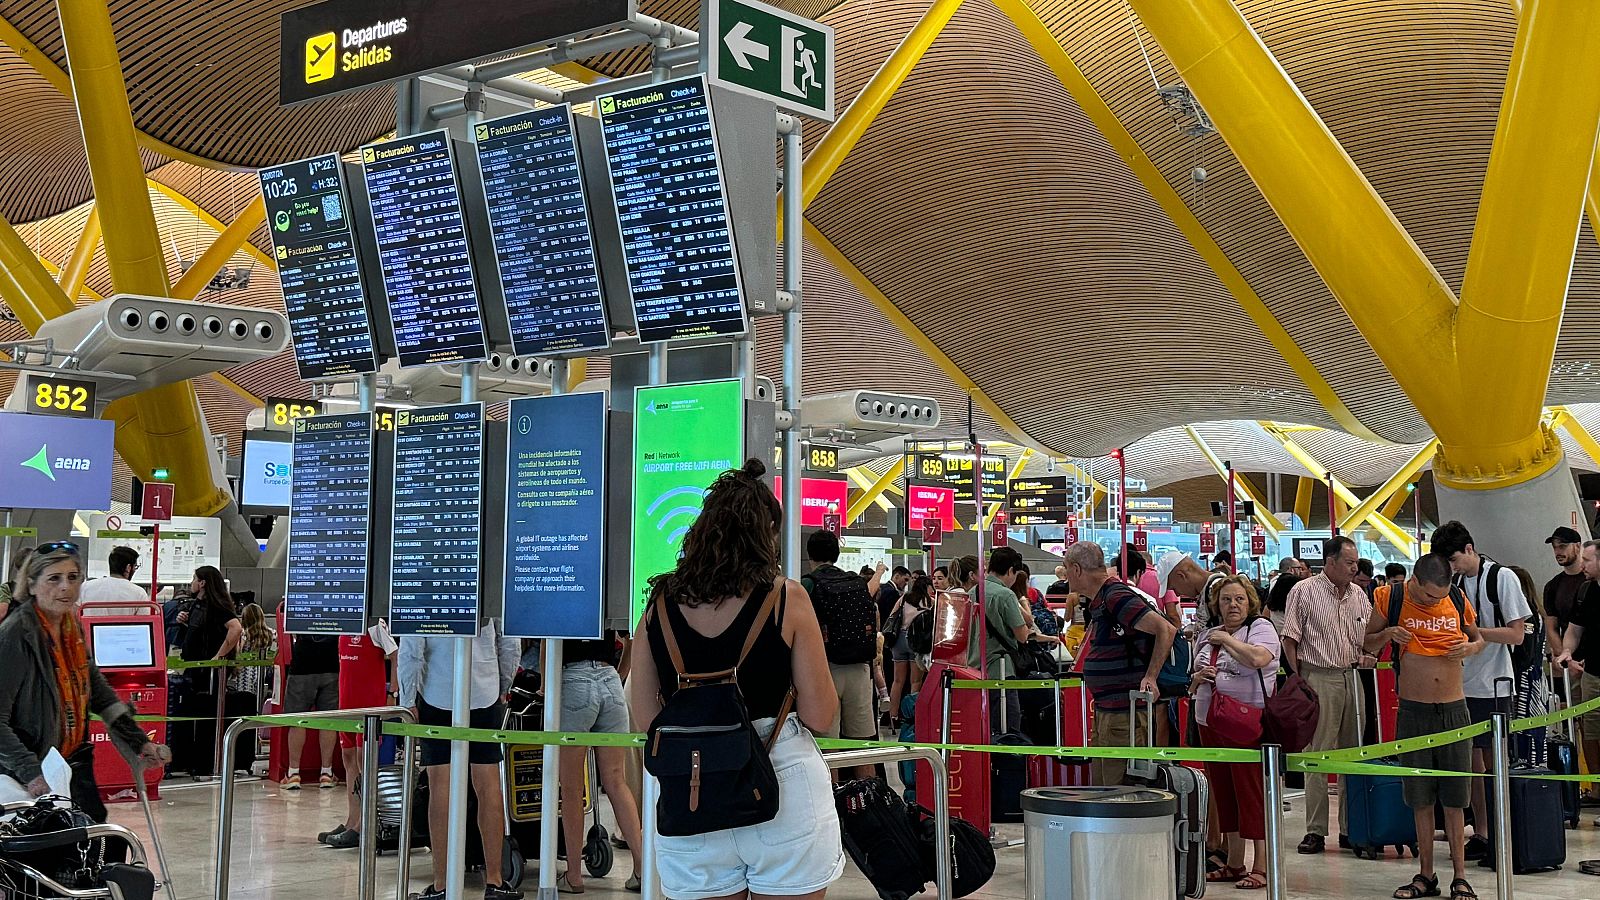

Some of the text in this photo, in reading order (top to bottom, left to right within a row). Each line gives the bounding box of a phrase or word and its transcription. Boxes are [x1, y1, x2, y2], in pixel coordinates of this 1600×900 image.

[343, 17, 407, 48] Departures
[342, 45, 391, 72] Salidas
[616, 85, 696, 109] Facturación Check-in
[489, 114, 562, 136] Facturación Check-in
[375, 139, 441, 159] Facturación Check-in
[263, 177, 298, 199] 10:25
[36, 383, 87, 411] 852
[410, 411, 475, 423] Facturación Check-in
[307, 419, 341, 430] Facturación
[55, 457, 90, 470] aena
[812, 450, 835, 467] 858
[644, 460, 731, 472] AIRPORT FREE WIFI AENA
[922, 459, 942, 475] 859
[153, 495, 162, 508] 1
[829, 522, 835, 531] 6
[929, 527, 935, 535] 7
[521, 535, 534, 543] global
[998, 531, 1002, 539] 8
[1069, 534, 1074, 542] 9
